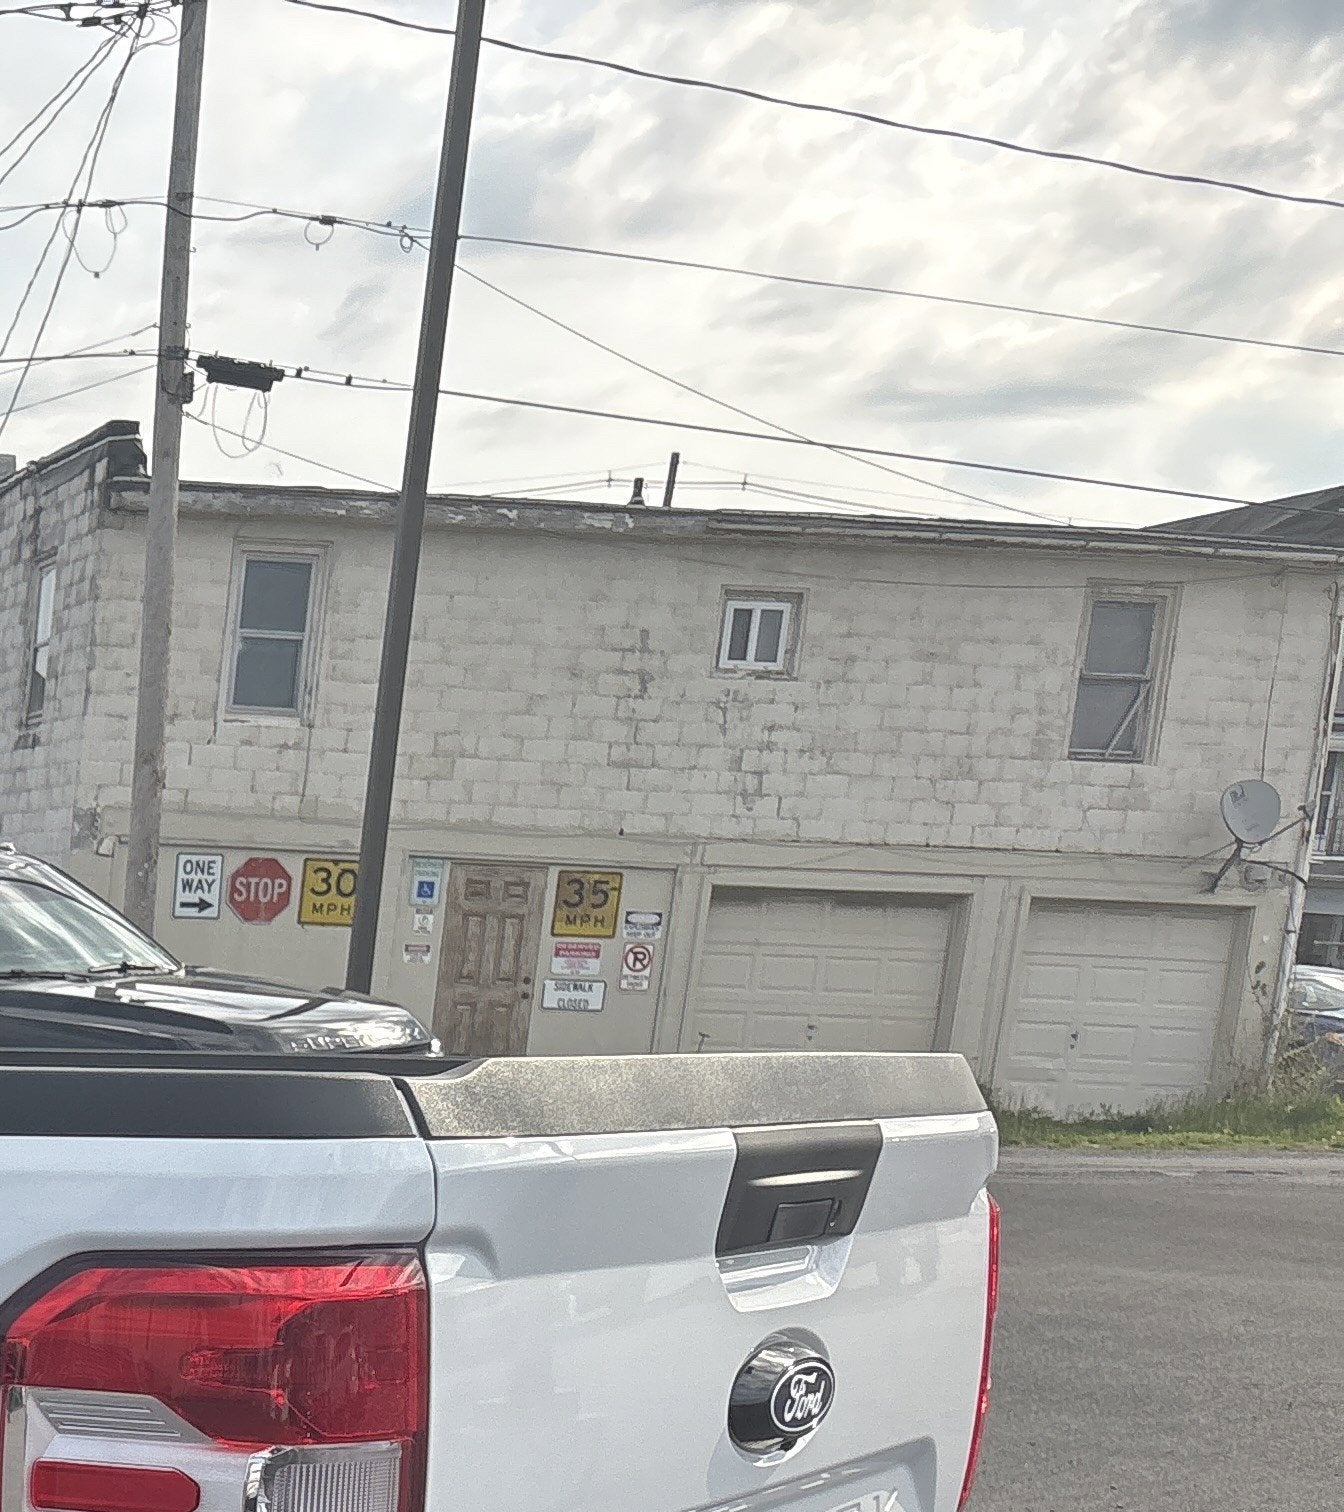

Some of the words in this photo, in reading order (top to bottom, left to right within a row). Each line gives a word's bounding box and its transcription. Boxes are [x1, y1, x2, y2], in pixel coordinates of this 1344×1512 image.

[182, 859, 217, 876] ONE
[181, 878, 216, 894] WAY
[233, 876, 288, 903] STOP
[310, 867, 357, 898] 30
[562, 878, 610, 910] 35
[312, 902, 352, 916] MPH
[564, 913, 606, 928] MPH
[553, 980, 594, 993] SIDEWALK
[556, 997, 590, 1010] CLOSED
[783, 1371, 826, 1423] Ford
